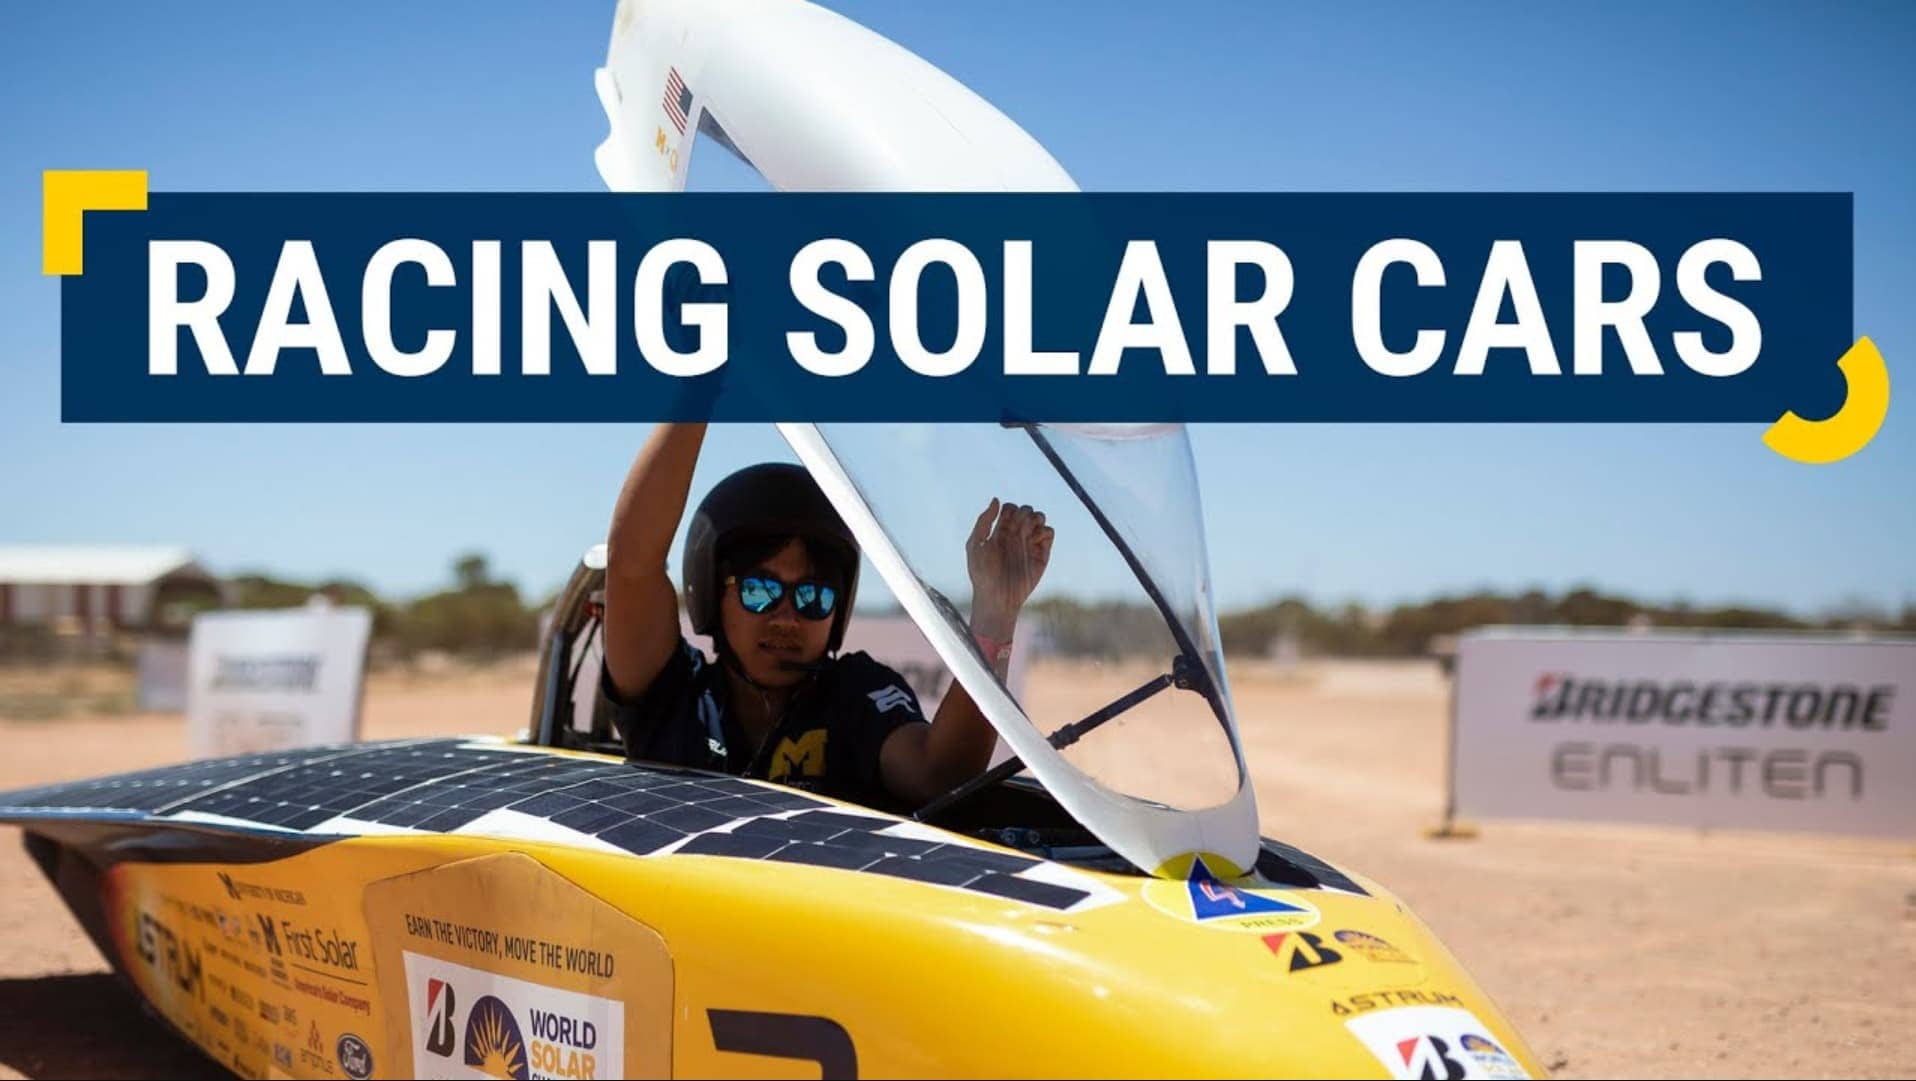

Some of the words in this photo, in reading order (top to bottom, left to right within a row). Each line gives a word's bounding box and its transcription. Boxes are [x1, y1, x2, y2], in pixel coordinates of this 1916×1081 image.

[1531, 673, 1897, 731] BRIDGESTONE
[281, 919, 315, 962] First
[314, 928, 359, 971] Solar
[405, 913, 434, 940] EARN
[432, 919, 454, 945] THE
[454, 924, 502, 960] VICTORY,
[504, 935, 537, 964] MOVE
[539, 941, 562, 969] THE
[565, 946, 615, 979] WORLD
[529, 1008, 597, 1050] WORLD
[530, 1040, 597, 1080] SOLAR
